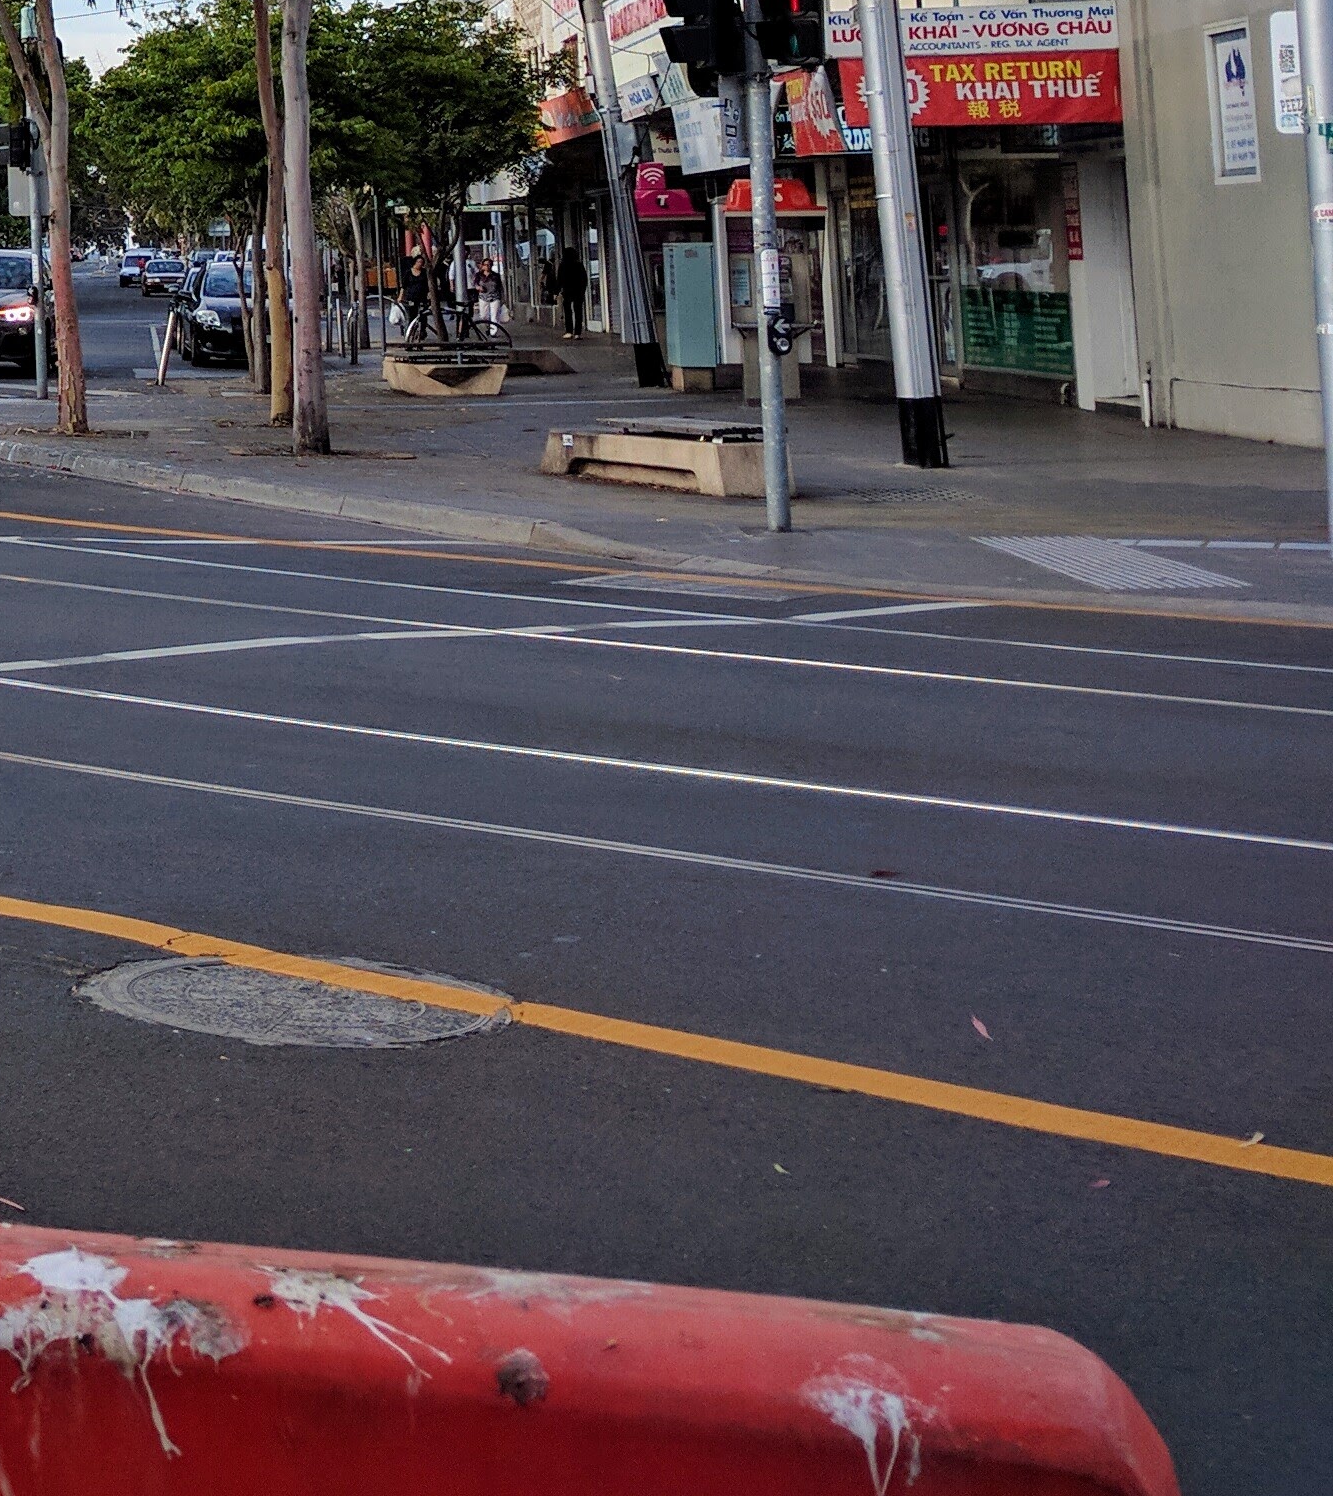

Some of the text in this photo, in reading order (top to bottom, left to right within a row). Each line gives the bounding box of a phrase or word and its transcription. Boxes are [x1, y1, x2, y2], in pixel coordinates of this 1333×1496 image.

[1057, 16, 1113, 35] CHÂU
[909, 41, 981, 51] ACCOUNTANTS
[1015, 39, 1033, 48] TAX
[1036, 38, 1069, 47] AGENT
[929, 59, 1083, 83] TAX RETURN
[956, 71, 1103, 101] KHAI THUẾ
